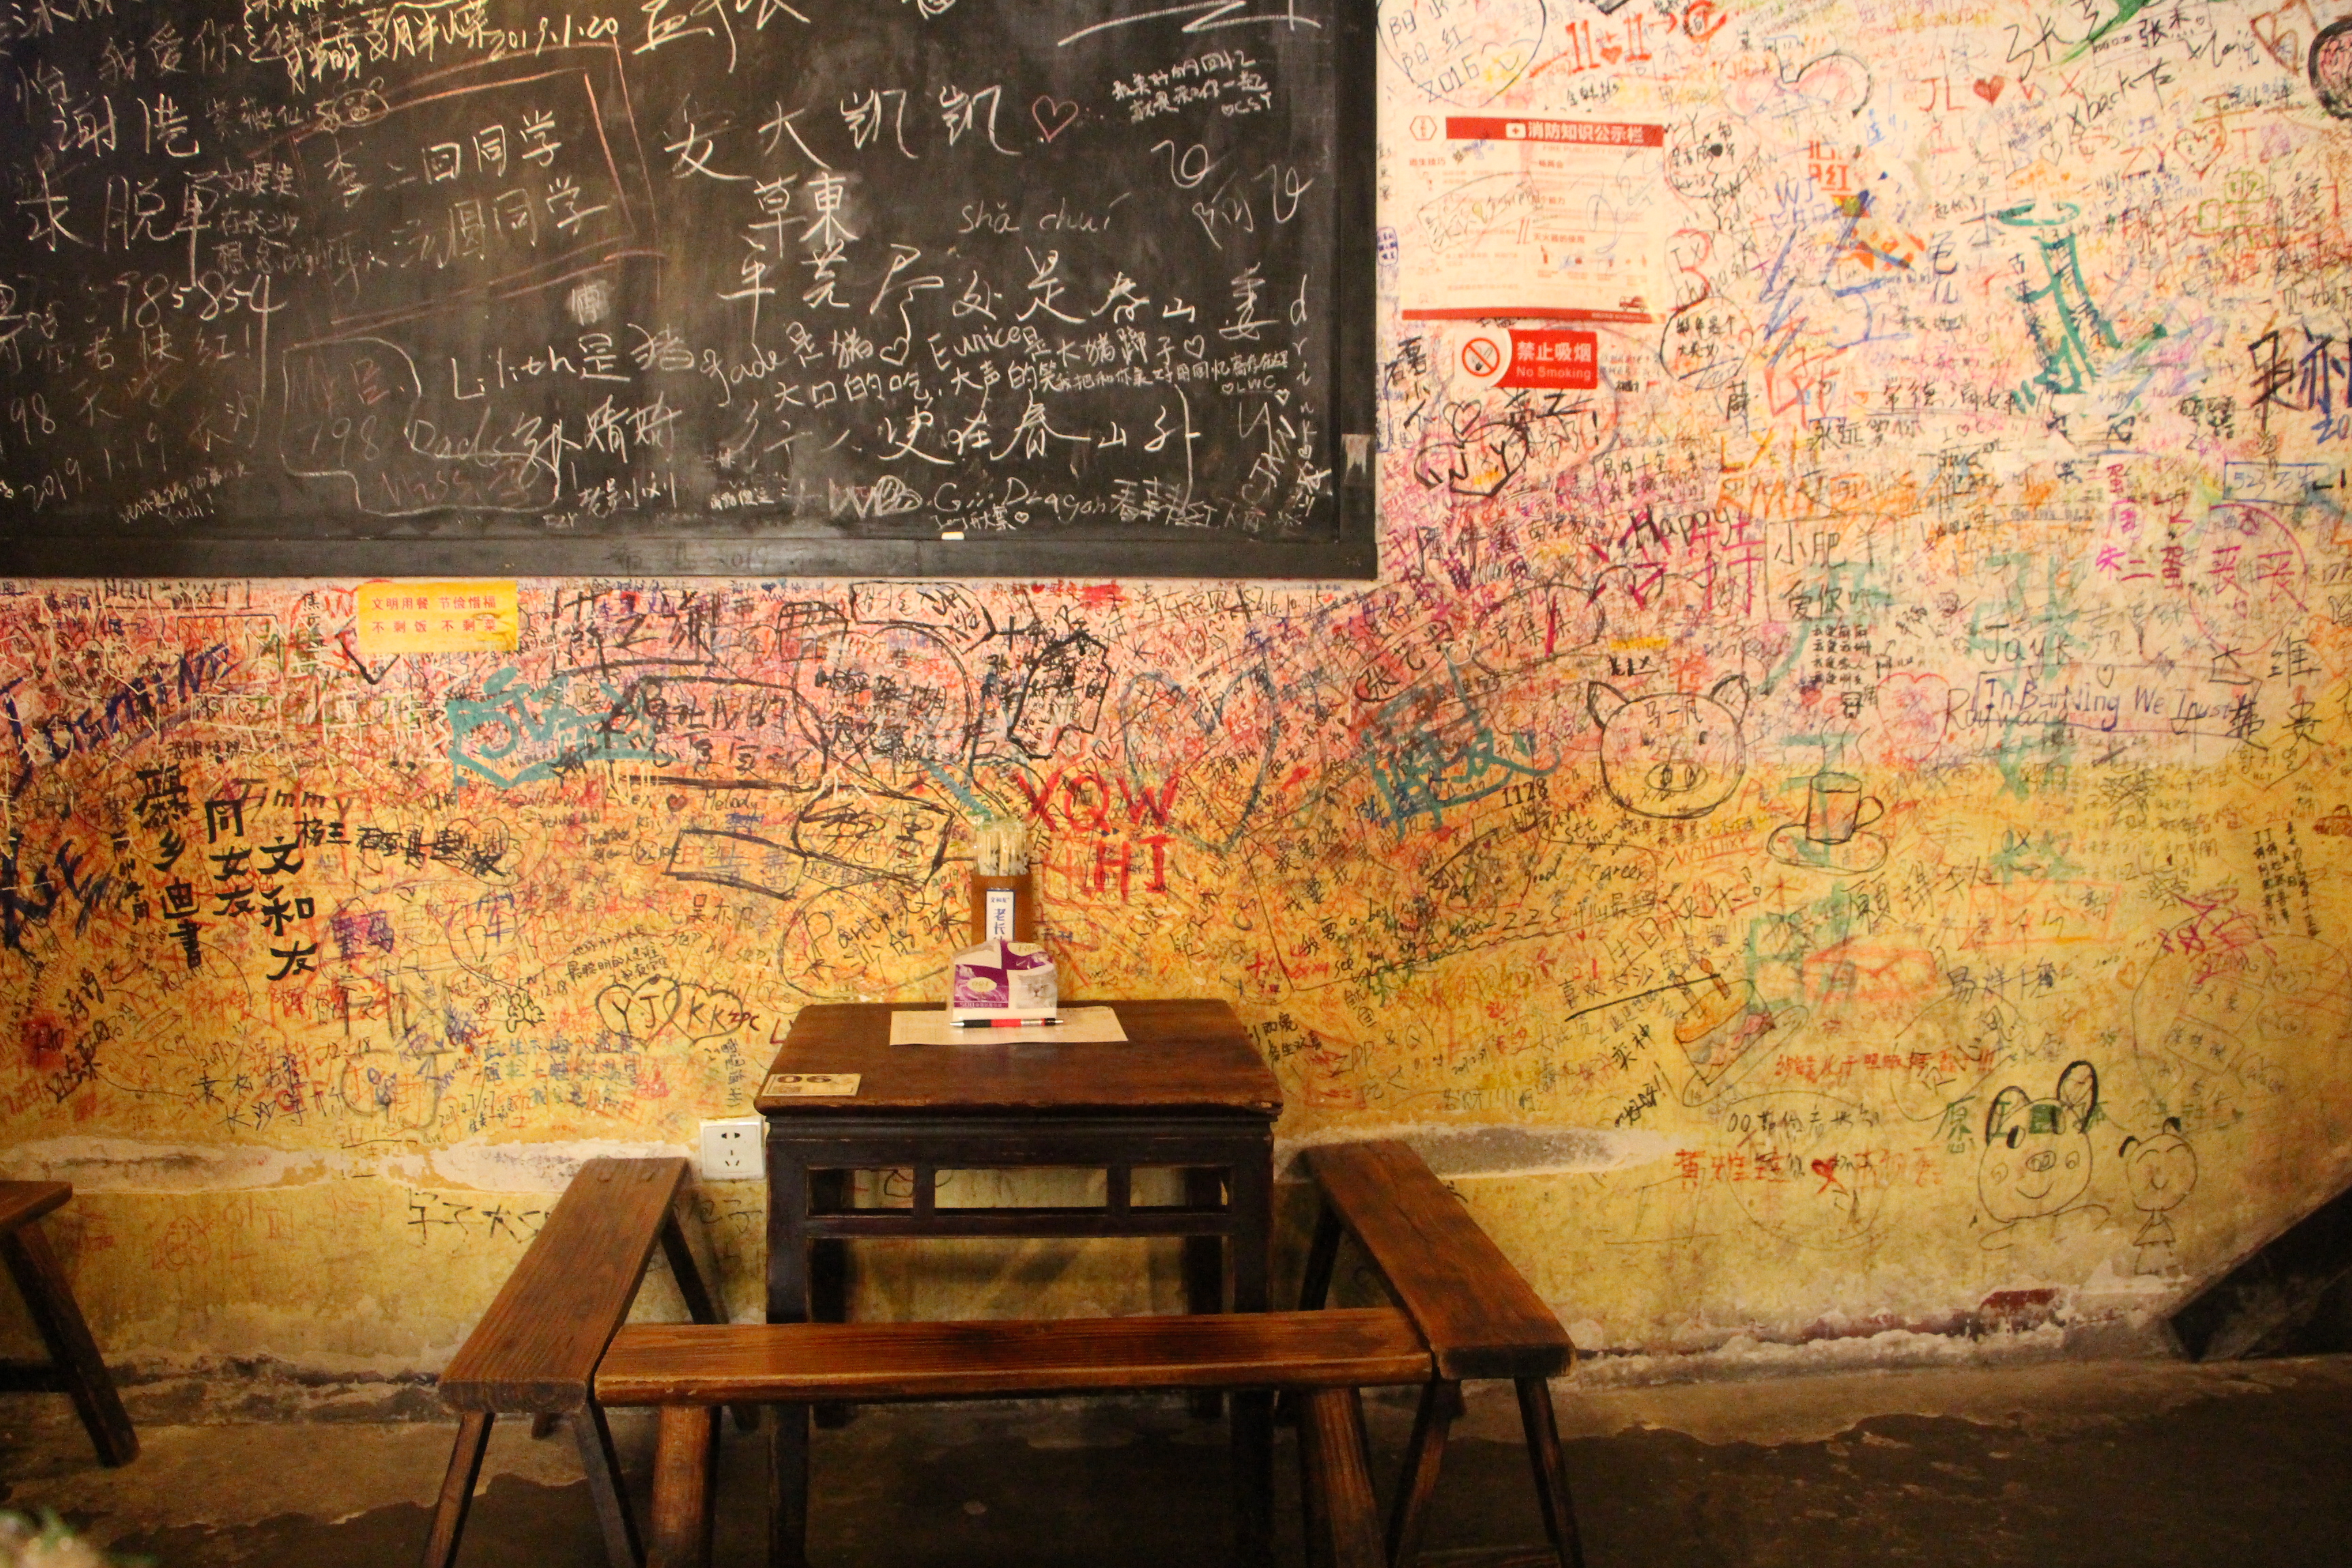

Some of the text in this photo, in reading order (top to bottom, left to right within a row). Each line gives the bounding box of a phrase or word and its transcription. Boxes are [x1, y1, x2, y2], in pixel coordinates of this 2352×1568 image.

[1529, 120, 1644, 144] 消防知识公示栏
[1517, 342, 1592, 363] 禁止吸烟
[1516, 365, 1592, 381] No Smoking
[371, 594, 497, 610] 文明用餐 节俭惜福
[372, 618, 497, 634] 不剩饭 不剩菜
[1501, 779, 1549, 808] 1128
[258, 835, 318, 980] 文和友
[777, 1075, 832, 1083] 06
